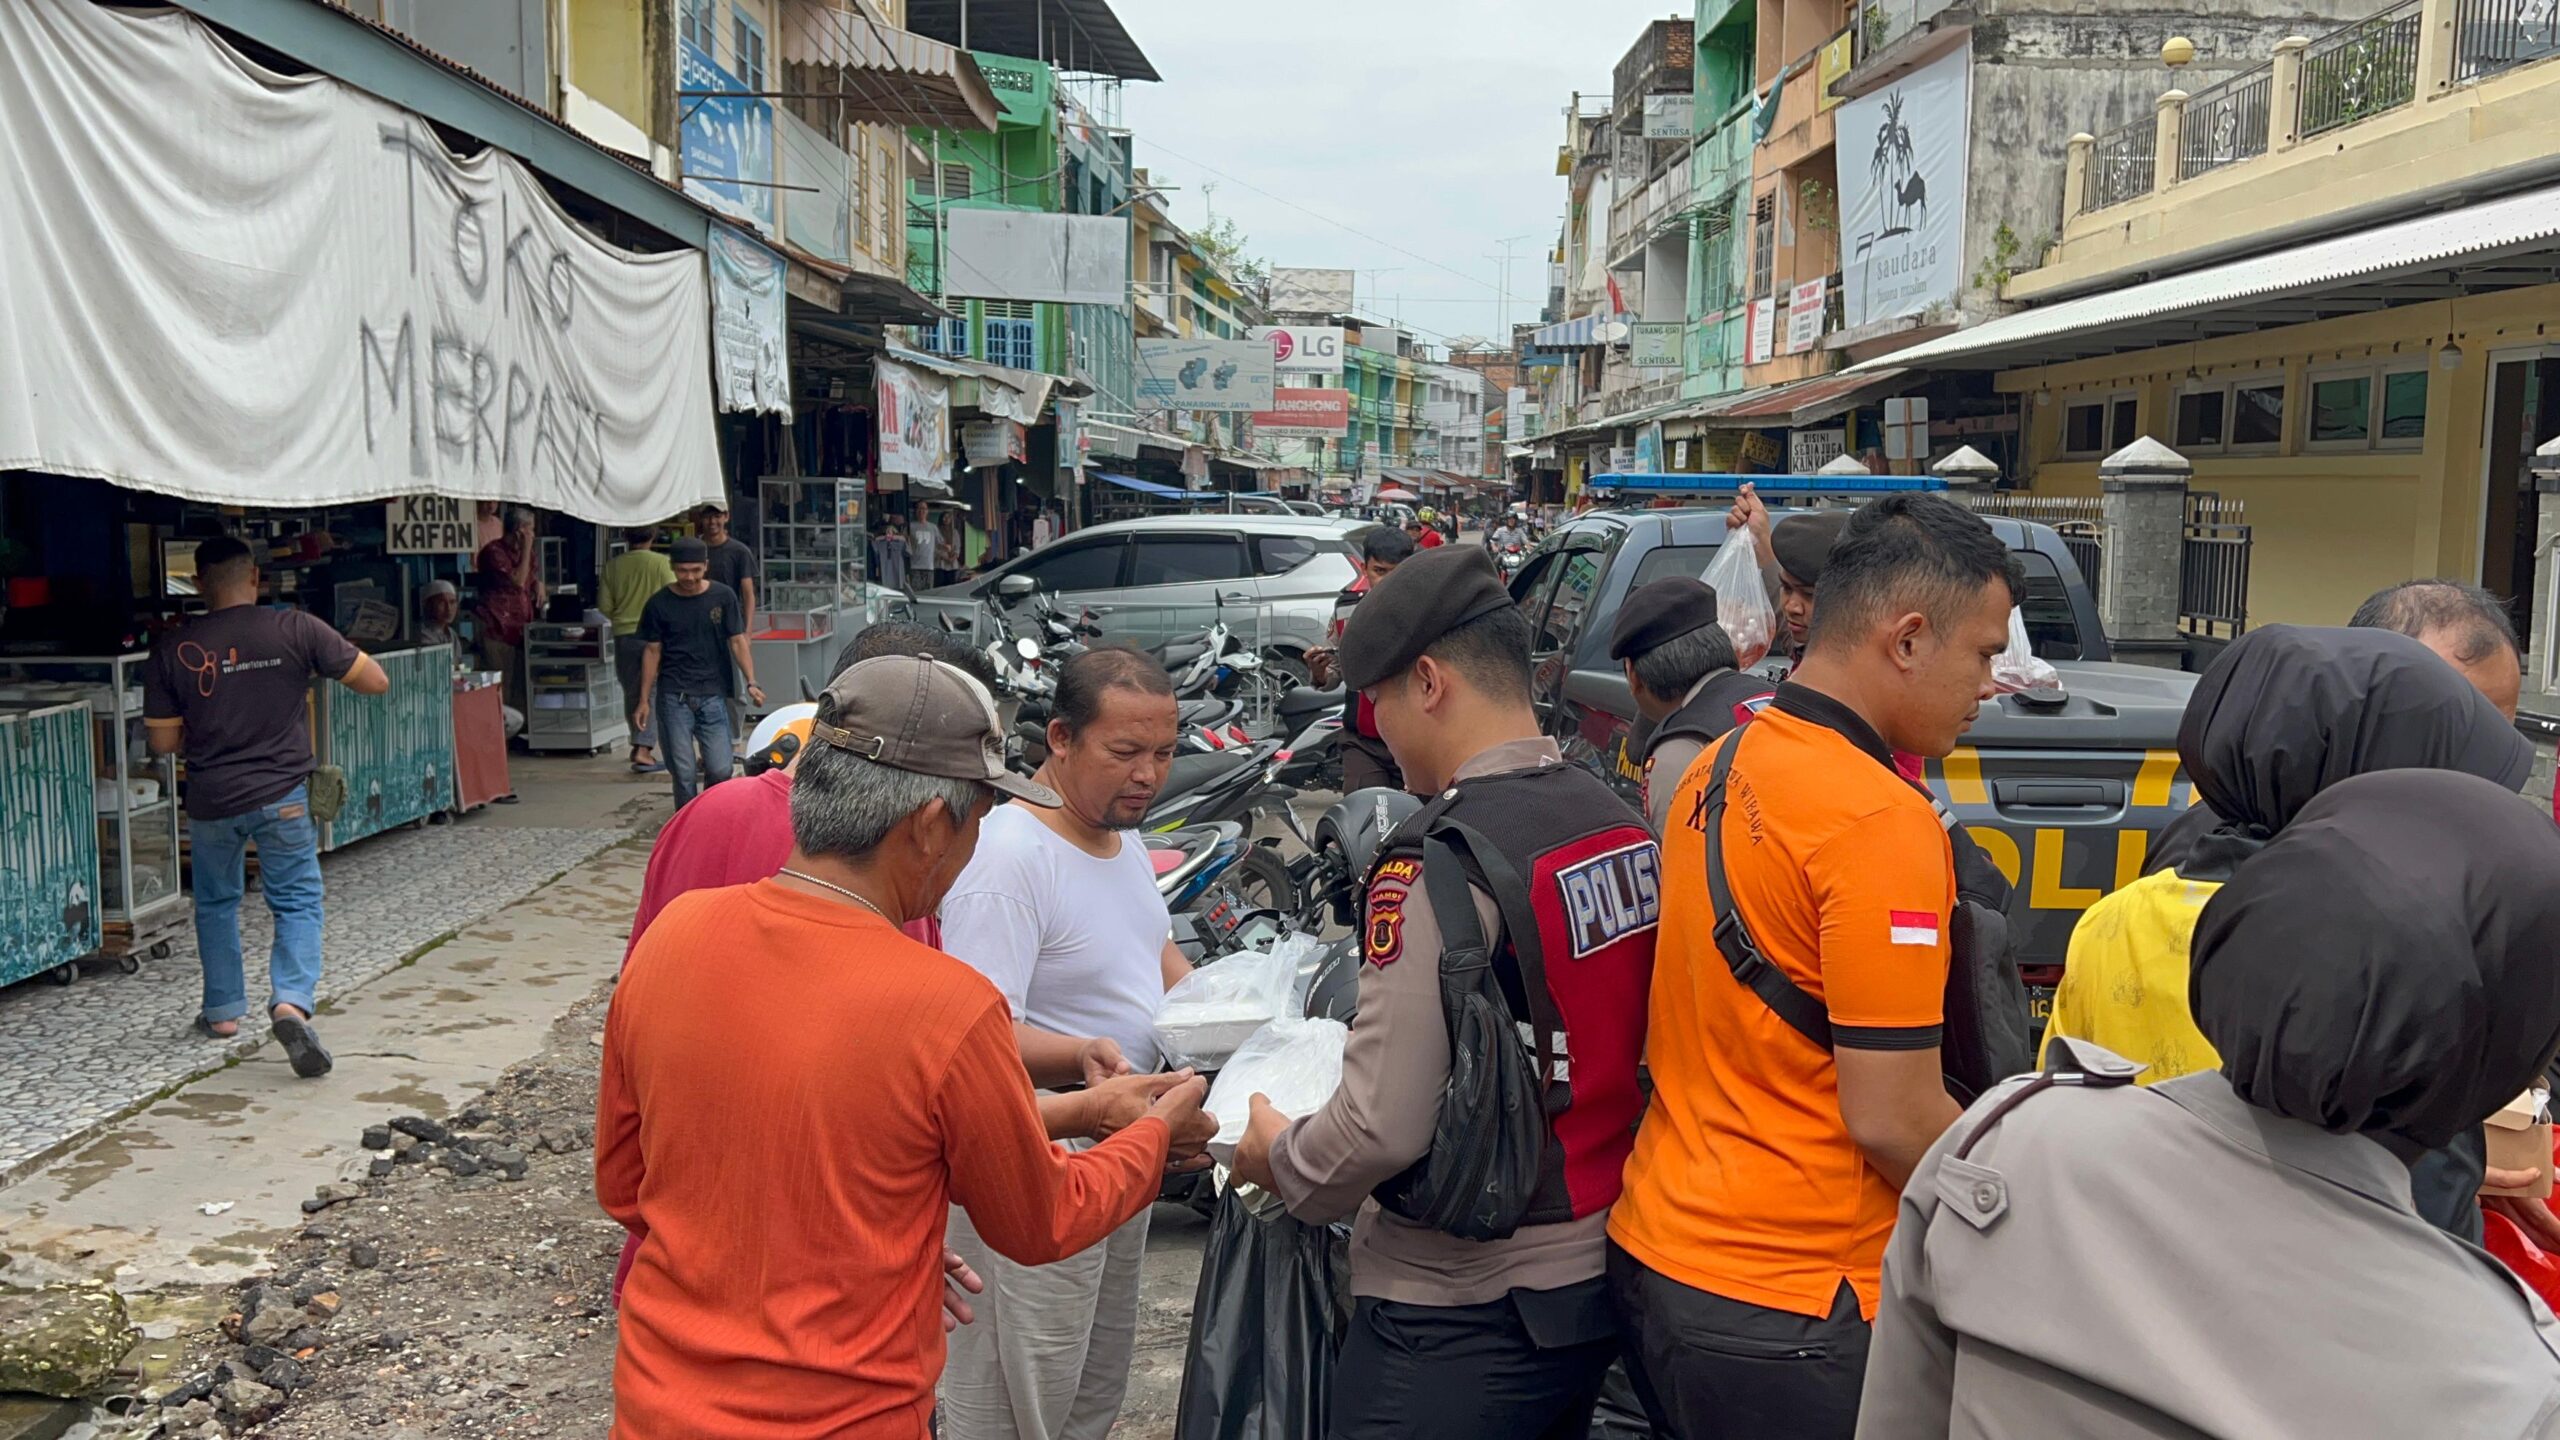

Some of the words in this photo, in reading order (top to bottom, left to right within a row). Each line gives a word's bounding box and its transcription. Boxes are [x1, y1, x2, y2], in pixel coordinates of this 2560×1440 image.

[1650, 128, 1690, 136] SENTOSA
[377, 119, 574, 333] TOKO
[1876, 242, 1936, 281] saudara
[1636, 326, 1663, 335] TUKANG
[1302, 336, 1334, 357] LG
[1638, 356, 1676, 365] SENTOSA
[360, 314, 607, 496] MERPATI
[1174, 400, 1227, 409] PANASONIC
[1228, 401, 1251, 409] JAYA
[1275, 399, 1341, 412] HANGHONG
[1803, 433, 1829, 444] DISINI
[1794, 444, 1819, 456] SEDIA
[1820, 442, 1843, 455] JUGA
[1792, 457, 1814, 473] KAIN
[392, 523, 472, 549] KAFAN
[1377, 860, 1414, 880] OLDA
